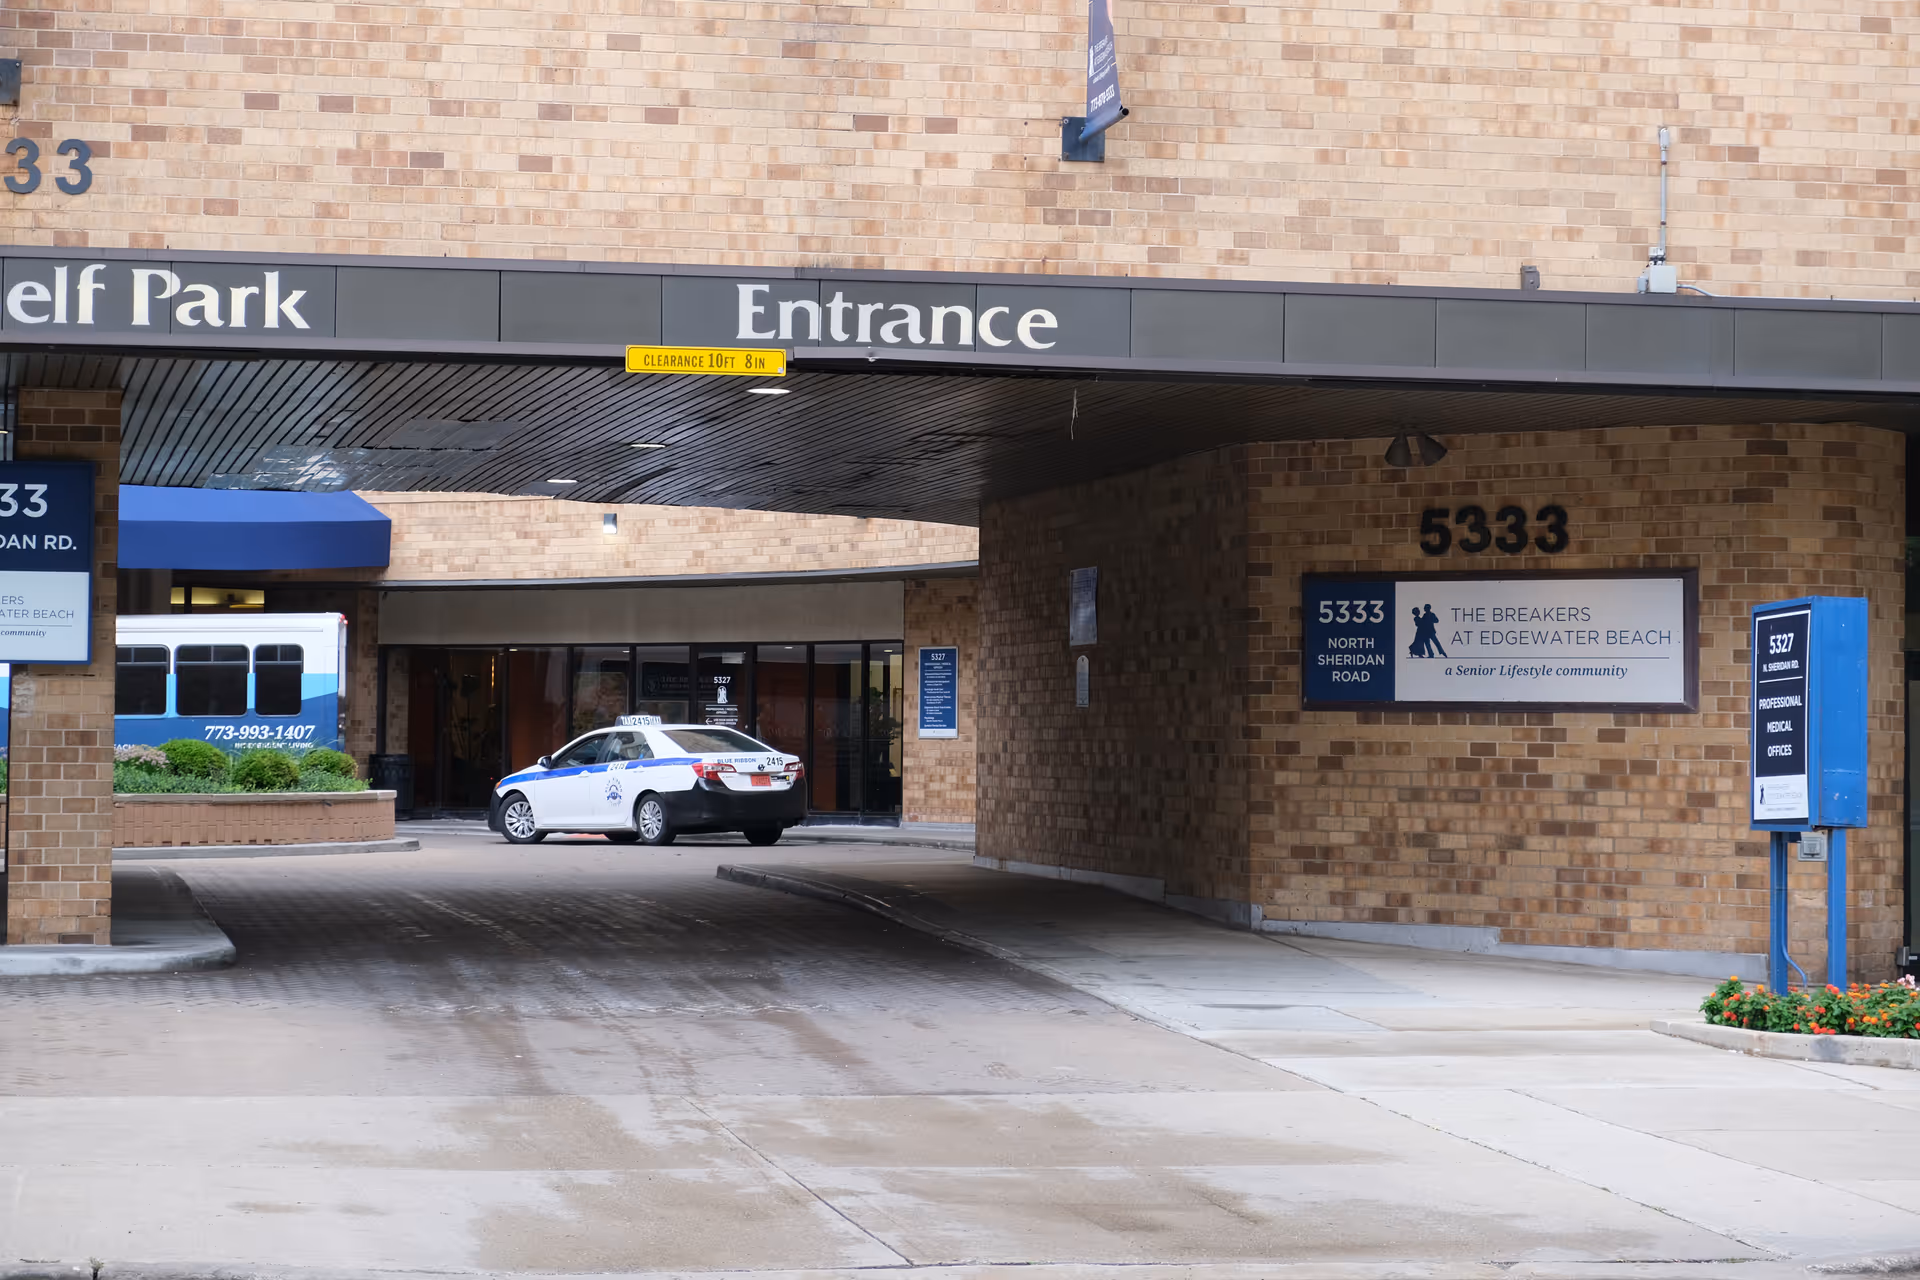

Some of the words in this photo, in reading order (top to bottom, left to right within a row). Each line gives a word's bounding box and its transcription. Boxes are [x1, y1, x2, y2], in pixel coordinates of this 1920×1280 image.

[3, 137, 93, 195] 33
[6, 264, 107, 324] elf
[131, 268, 311, 329] Park
[736, 283, 1058, 349] Entrance
[643, 354, 704, 368] CLEARANCE
[1420, 504, 1570, 555] 5333
[44, 535, 77, 550] RD.
[33, 609, 75, 619] BEACH
[1318, 600, 1385, 624] 5333
[1450, 607, 1486, 622] THE
[1492, 606, 1592, 622] BREAKERS
[0, 628, 47, 638] community
[1450, 630, 1474, 646] AT
[1480, 630, 1600, 646] EDGEWATER
[1606, 629, 1671, 646] BEACH
[1328, 637, 1375, 650] NORTH
[1769, 633, 1795, 655] 5327
[931, 653, 946, 661] 5327
[1317, 654, 1386, 667] SHERIDAN
[1445, 666, 1453, 677] a
[1455, 664, 1497, 678] Senior
[1499, 663, 1553, 680] Lifestyle
[1556, 663, 1628, 680] community
[1768, 661, 1791, 672] SHERIDAN
[1791, 661, 1800, 671] RD.
[713, 676, 731, 684] 5327
[1332, 671, 1371, 683] ROAD
[1758, 696, 1803, 710] PROFESSIONAL
[632, 716, 651, 726] 2415
[1766, 720, 1793, 734] MEDICAL
[204, 725, 316, 740] 773-993-1407
[1767, 744, 1793, 757] OFFICES
[766, 756, 784, 766] 2415
